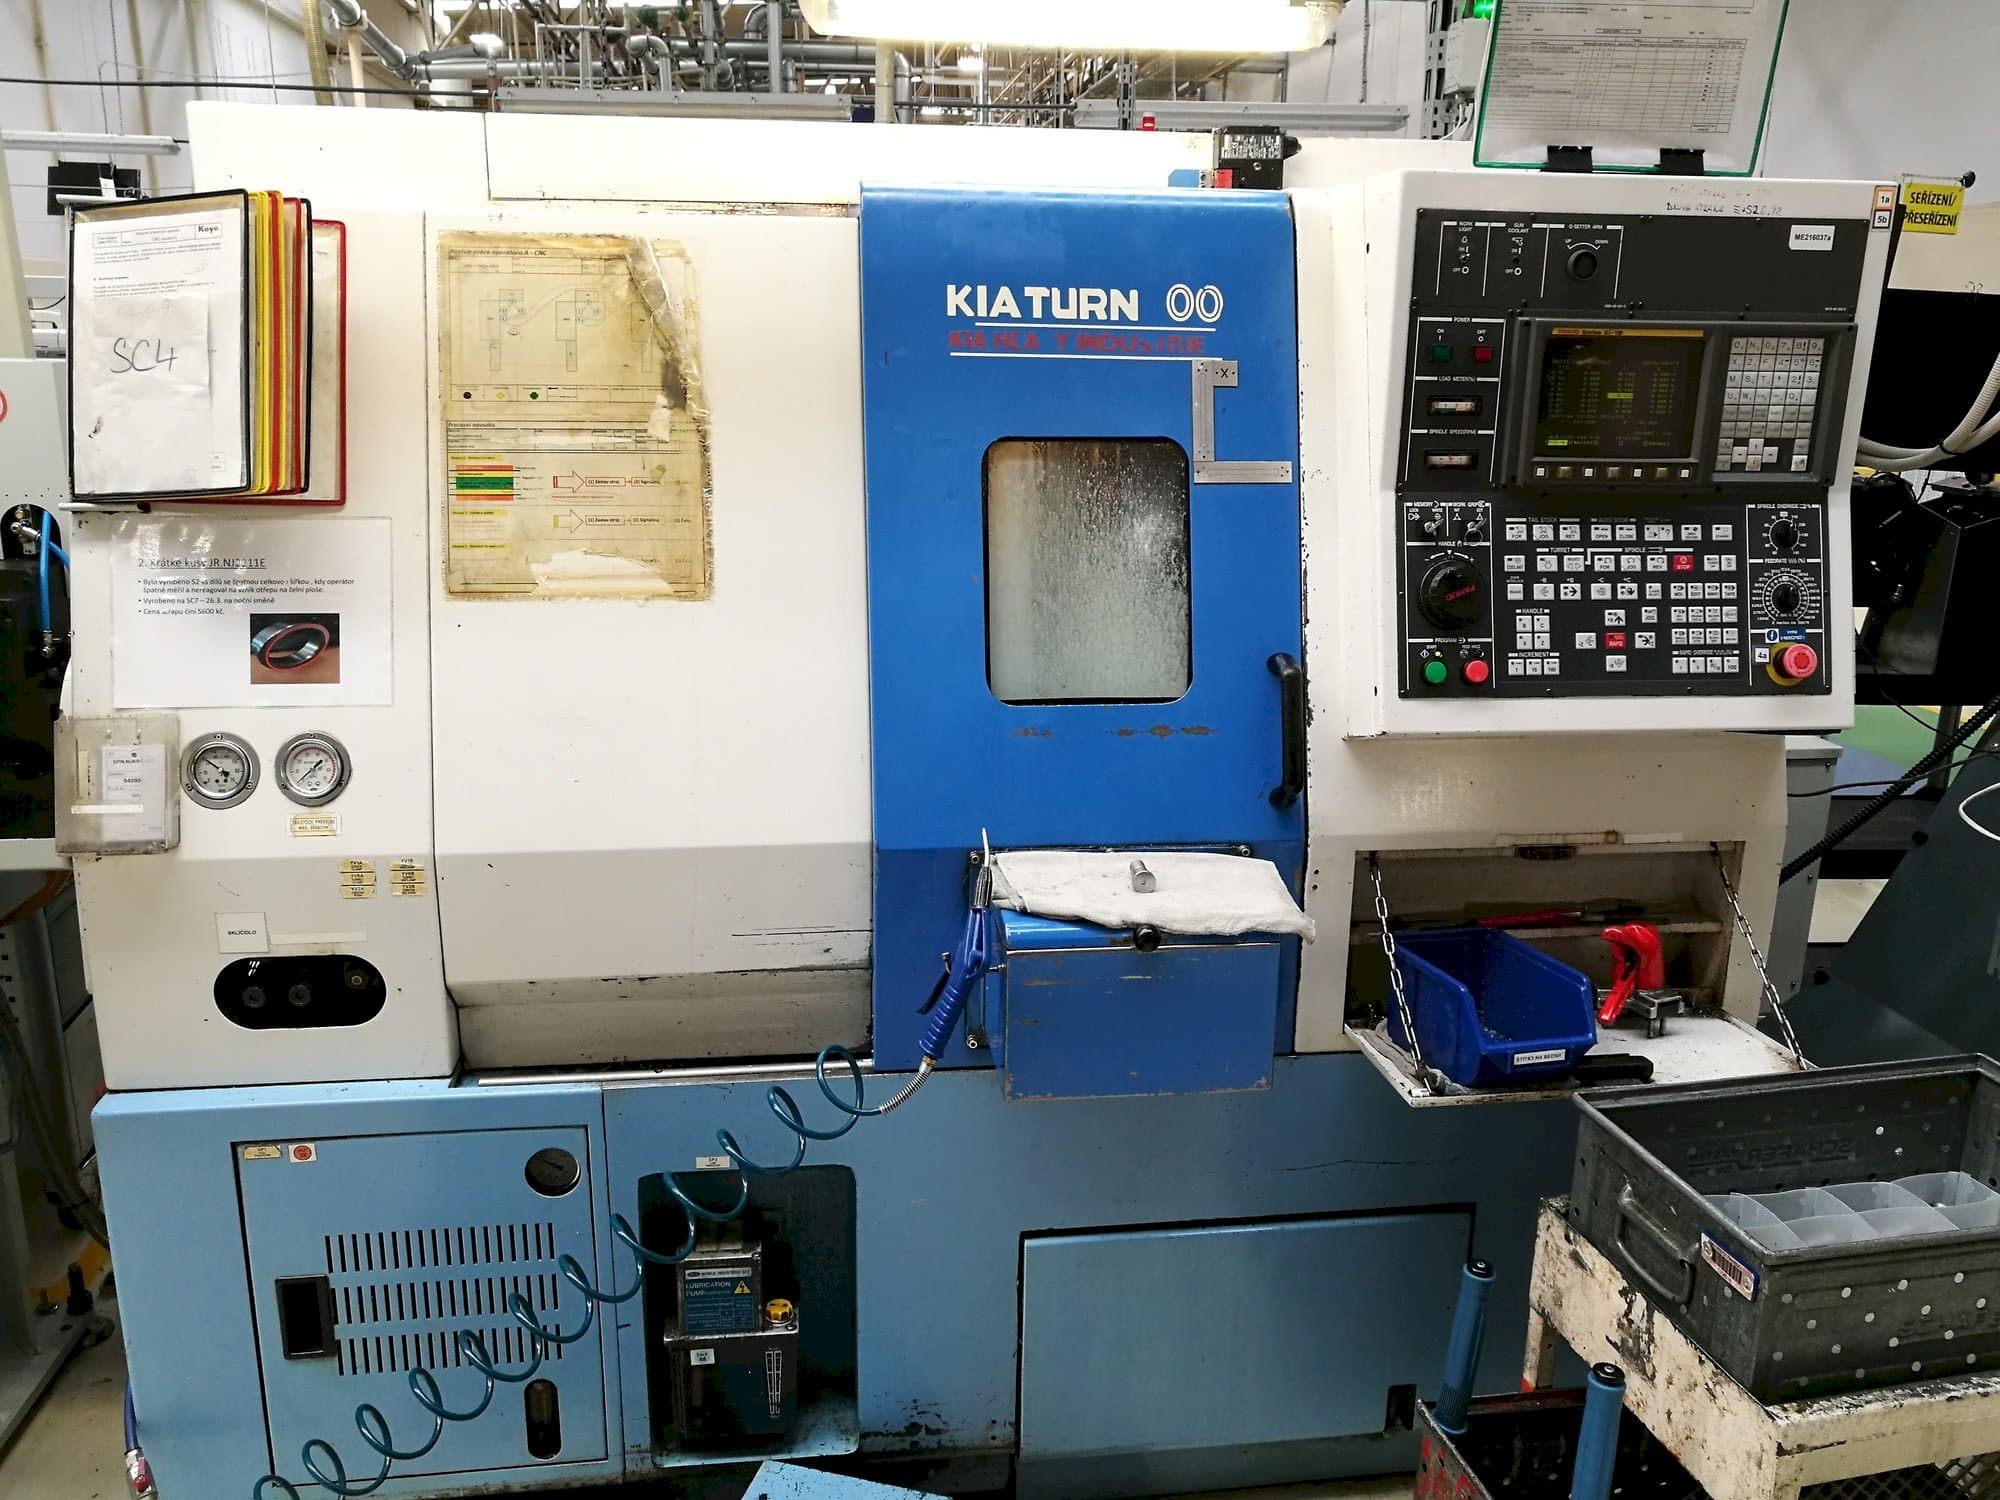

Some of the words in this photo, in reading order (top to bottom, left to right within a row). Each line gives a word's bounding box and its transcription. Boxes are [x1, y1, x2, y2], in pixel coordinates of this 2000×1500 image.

[1880, 195, 1890, 204] 1a
[1877, 215, 1888, 224] 5b
[198, 225, 219, 233] Koyo
[1794, 233, 1832, 242] ME216037a
[992, 331, 1069, 351] HEAY
[110, 337, 178, 373] SC4
[685, 1280, 731, 1289] LUBRICATION
